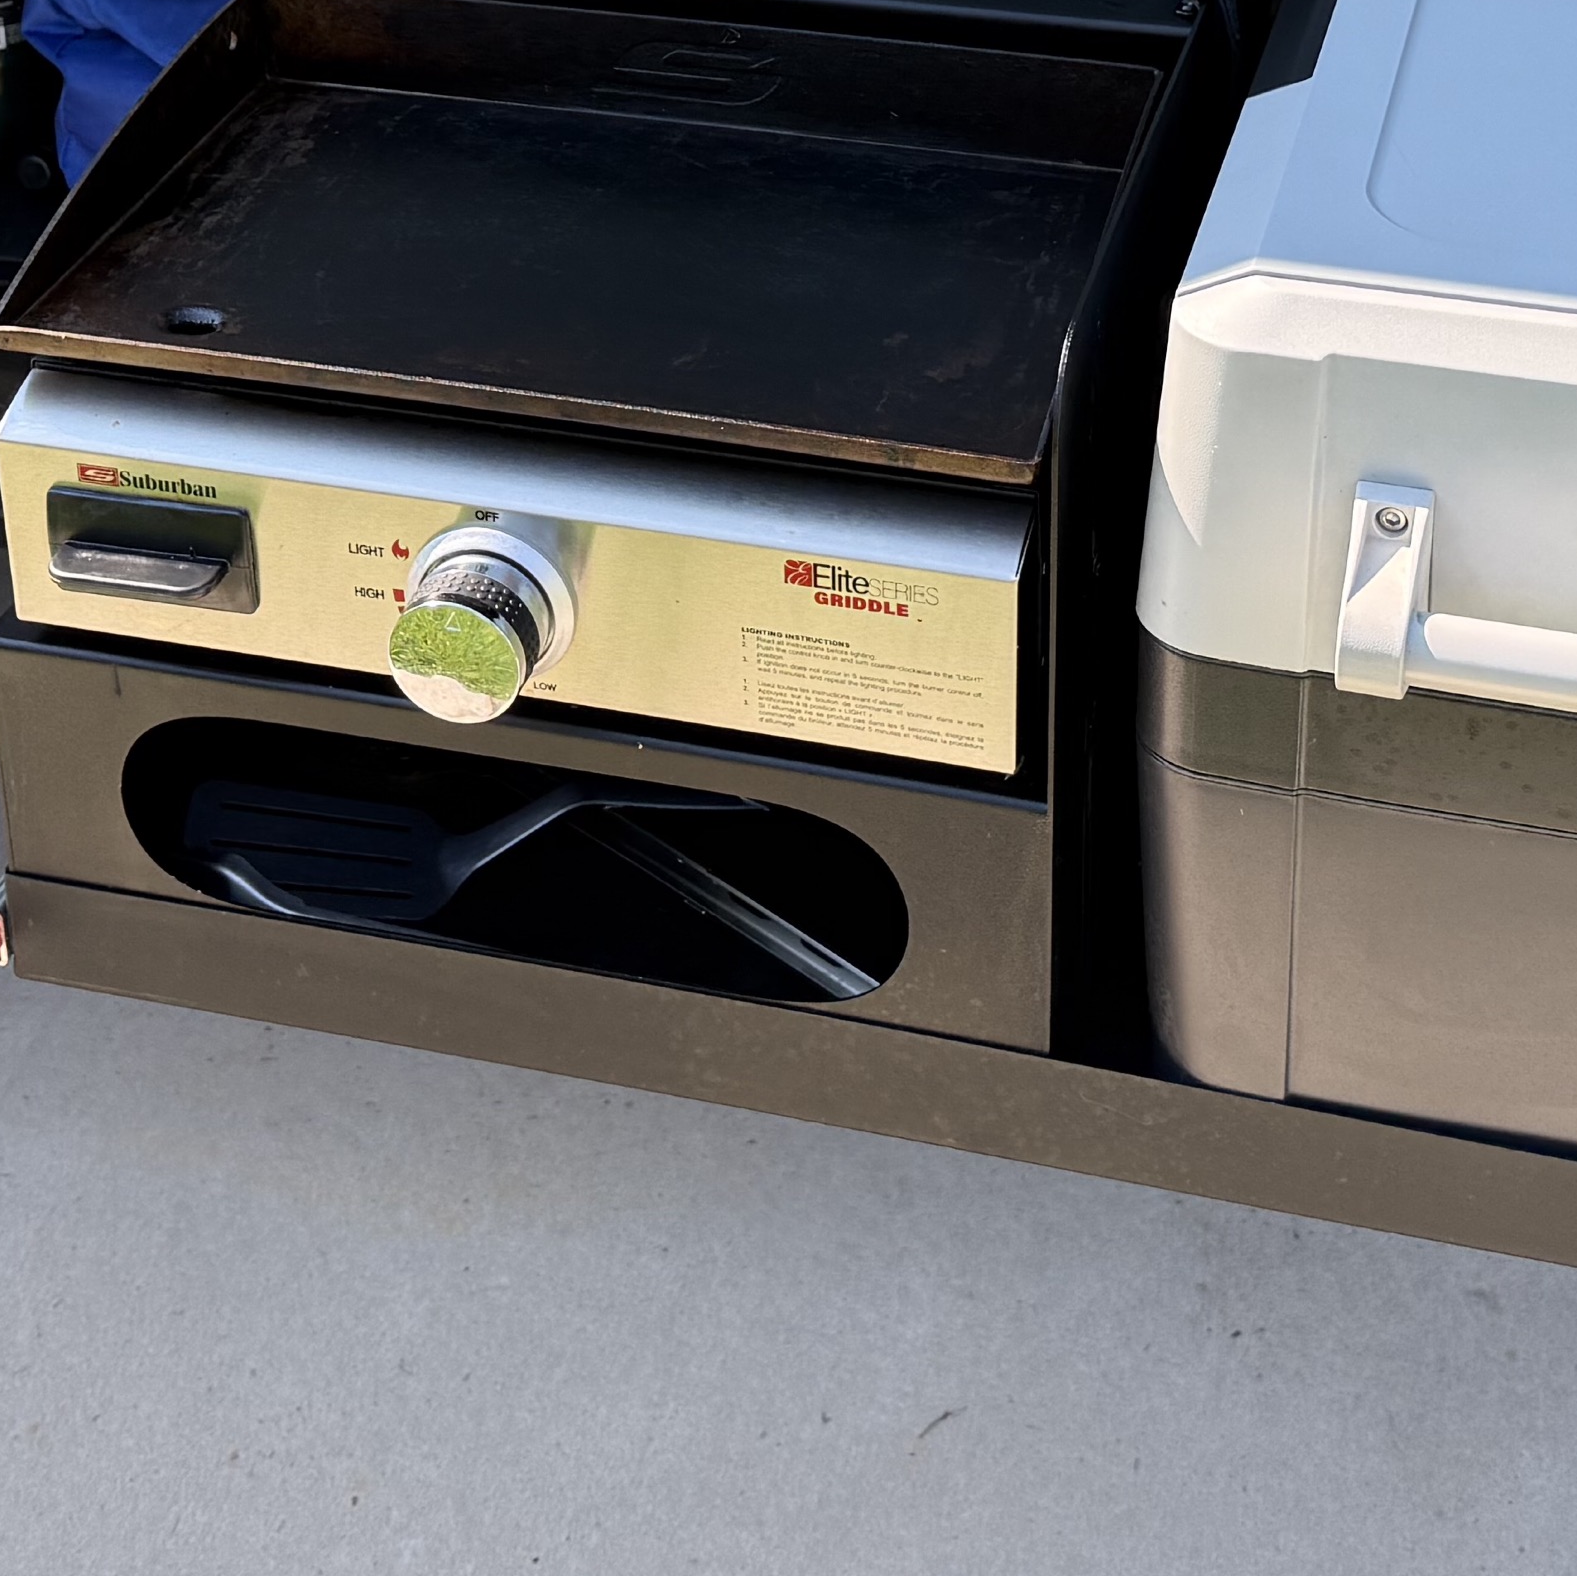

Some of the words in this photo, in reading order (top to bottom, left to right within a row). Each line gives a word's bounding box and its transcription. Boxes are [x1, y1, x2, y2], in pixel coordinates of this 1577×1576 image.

[119, 470, 217, 499] Suburban
[475, 510, 499, 522] OFF
[348, 542, 385, 557] LIGHT
[354, 586, 385, 600] HIGH
[814, 591, 909, 617] GRIDDLE
[741, 626, 782, 637] LIGHTING
[785, 633, 849, 648] INSTRUCTIONS
[533, 681, 557, 691] LOW
